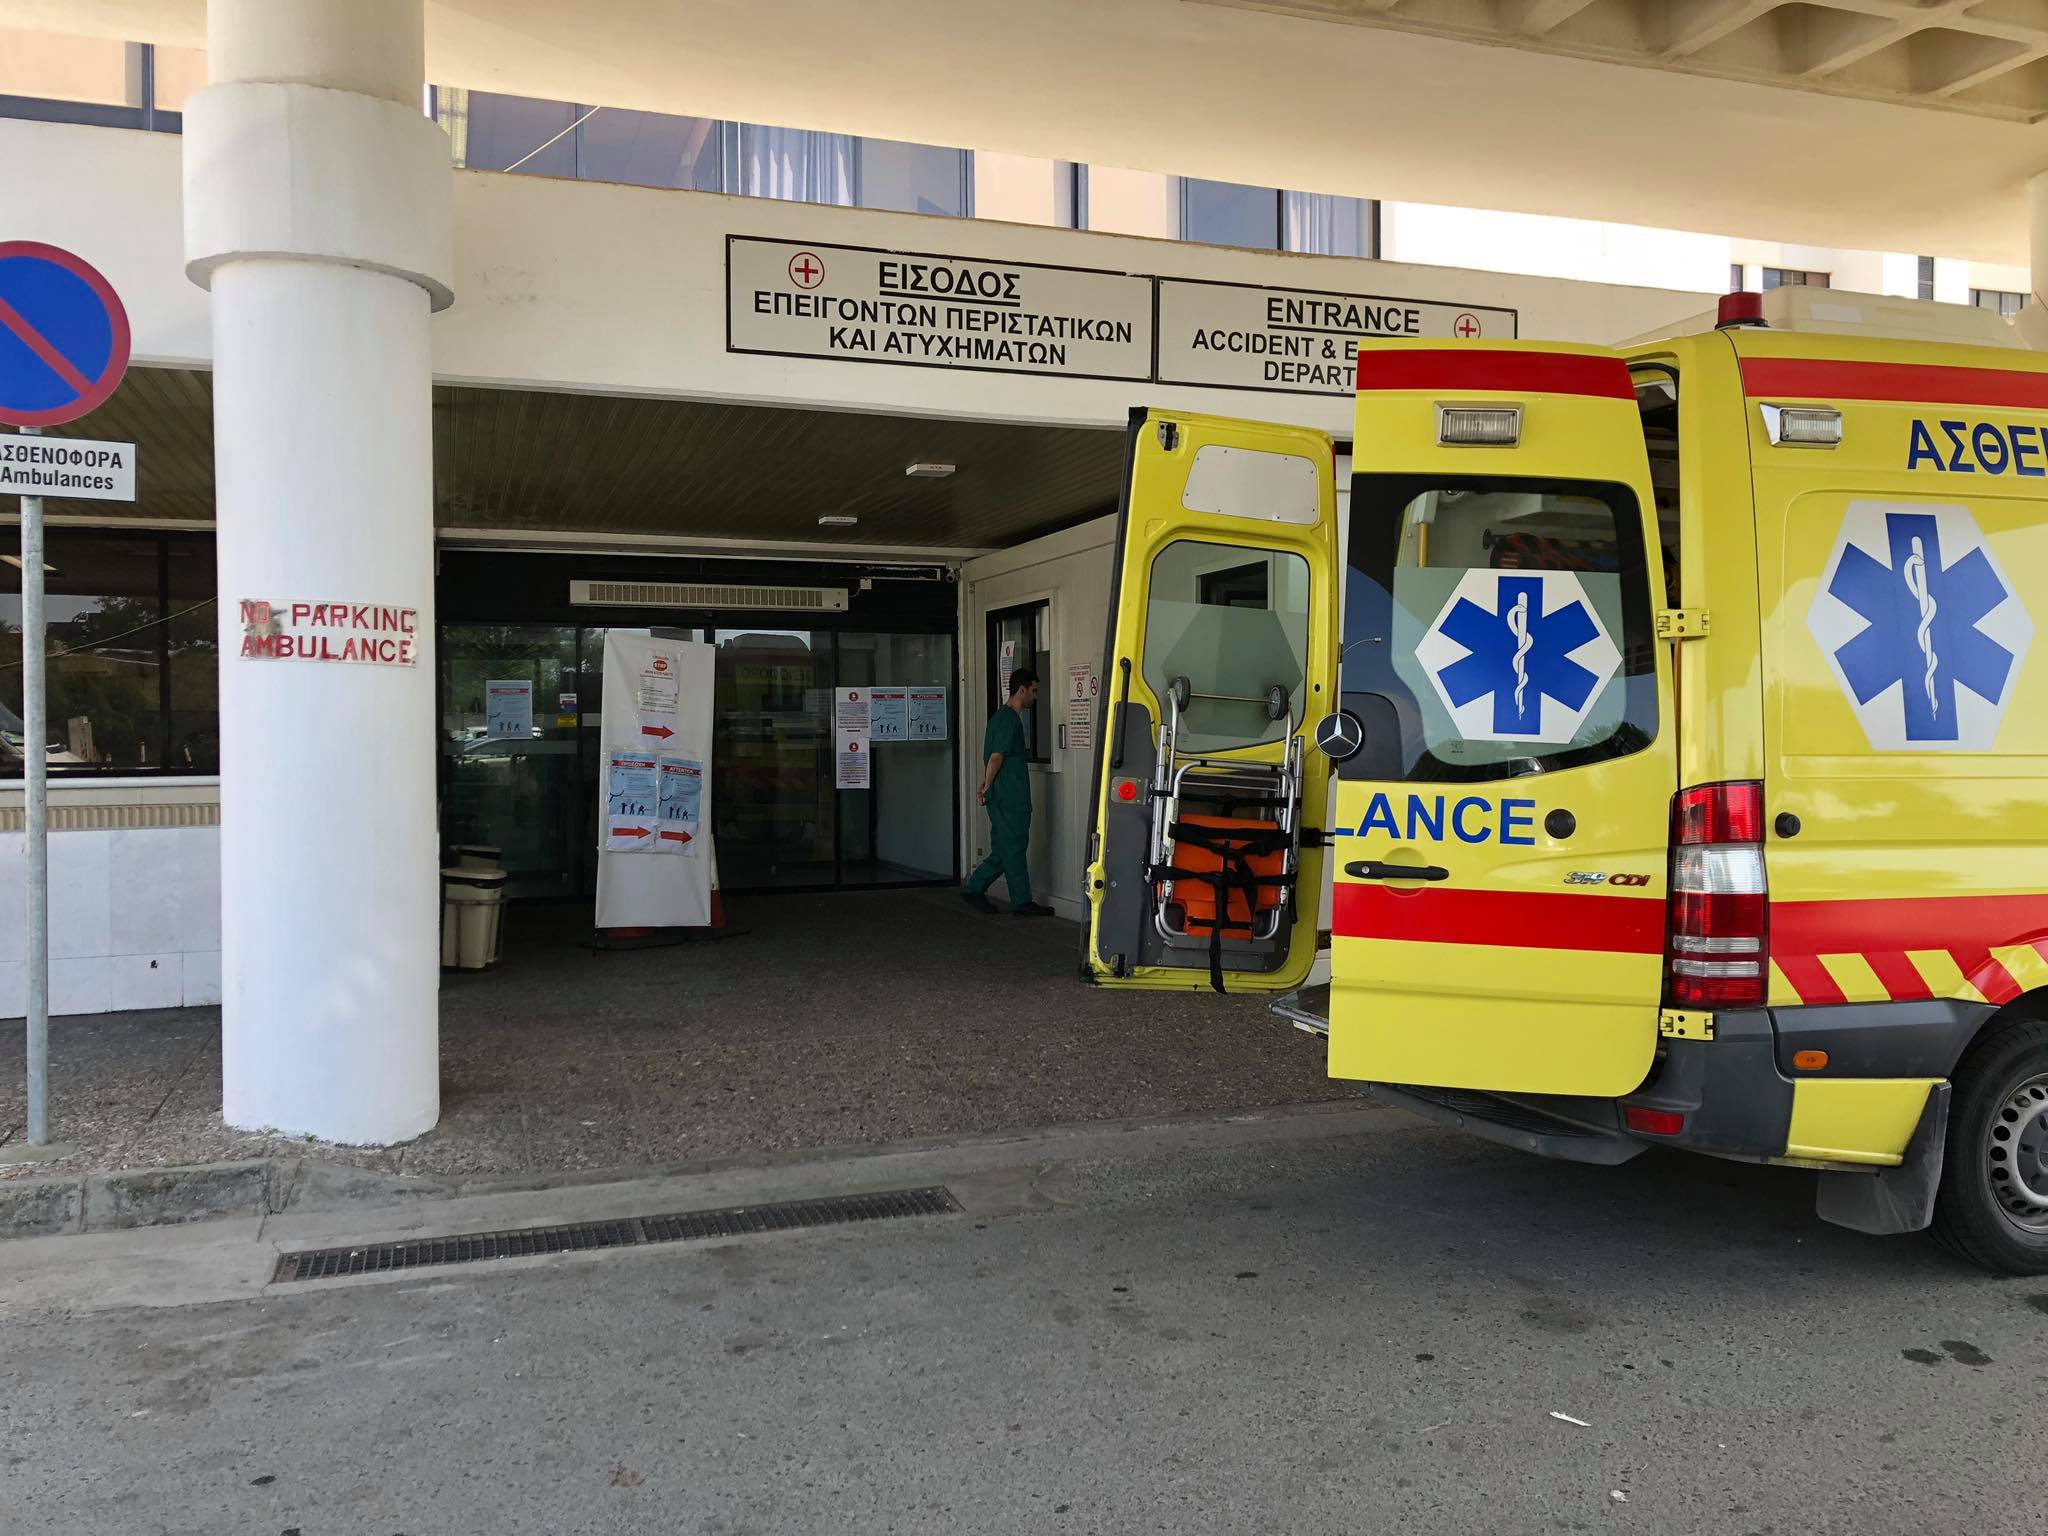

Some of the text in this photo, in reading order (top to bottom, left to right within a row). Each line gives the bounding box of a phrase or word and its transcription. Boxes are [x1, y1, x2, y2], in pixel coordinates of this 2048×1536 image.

[879, 261, 1021, 300] ΕΙΣΟΔΟΣ
[754, 290, 1132, 343] ΕΠΕΙΓΟΝΤΩΝ ΠΕΡΙΣΤΑΤΙΚΩΝ
[1266, 296, 1420, 334] ENTRANCE
[829, 326, 1066, 365] ΚΑΙ ΑΤΥΧΗΜΑΤΩΝ
[1191, 328, 1315, 358] ACCIDENT
[1321, 338, 1337, 360] &
[0, 444, 123, 469] ΣΘΕΝΟΦΟΡΑ
[0, 466, 114, 490] Ambulances
[240, 634, 412, 664] AMBULANCE
[1608, 873, 1651, 887] CDI
